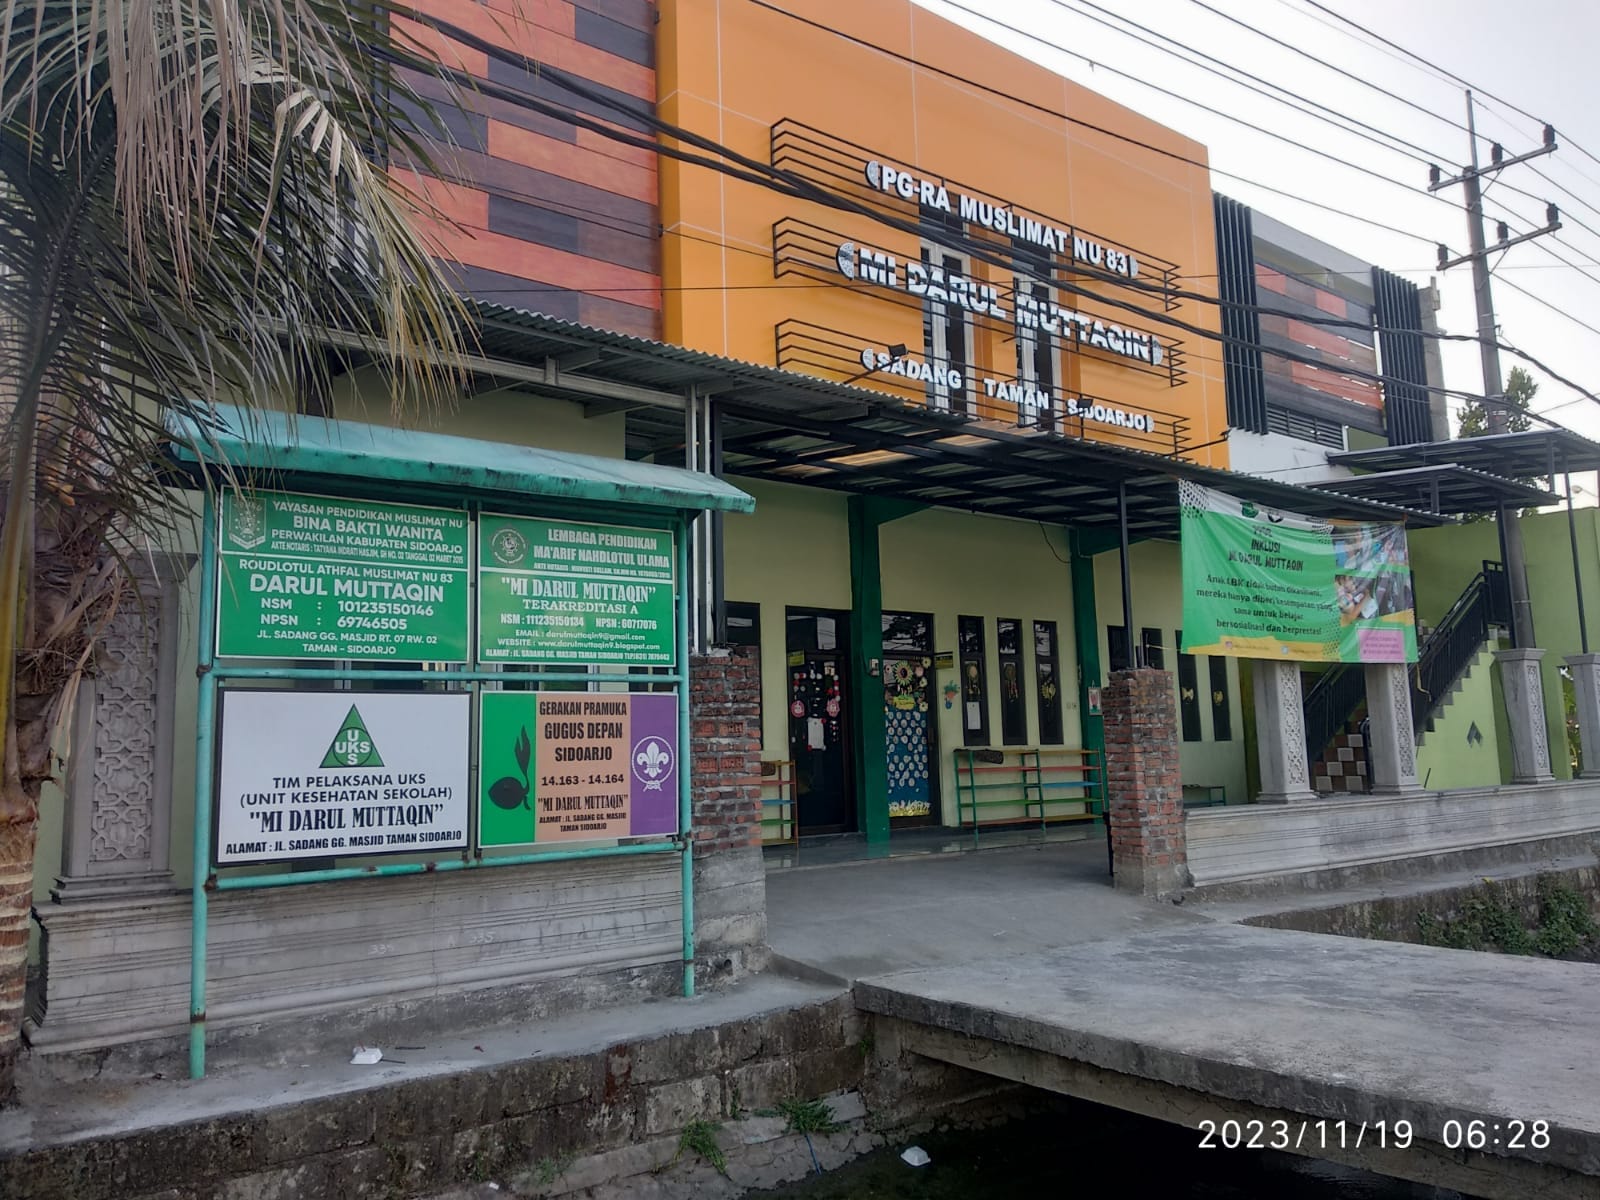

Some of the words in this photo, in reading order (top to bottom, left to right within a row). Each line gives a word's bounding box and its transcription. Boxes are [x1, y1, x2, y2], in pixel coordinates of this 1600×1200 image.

[881, 166, 951, 213] PG-RA
[960, 195, 1068, 251] MUSLIMAT
[1074, 236, 1101, 264] NU
[1105, 248, 1128, 274] 83
[858, 248, 897, 286] MI
[905, 262, 1007, 320] DARUL
[1015, 295, 1151, 360] MUTTAQIN
[876, 353, 962, 390] SADANG
[984, 378, 1049, 409] TAMAN
[273, 501, 324, 514] YAYASAN
[327, 506, 392, 521] PENDIDIKAN
[394, 513, 447, 527] MUSLIMAT
[449, 519, 463, 528] NU
[293, 515, 332, 531] BINA
[335, 519, 380, 535] BAKTI
[384, 524, 444, 541] WANITA
[271, 529, 344, 544] PERWAKILAN
[346, 535, 407, 549] KABUPATEN
[409, 541, 463, 553] SIDOARJO
[548, 529, 596, 544] LEMBAGA
[598, 533, 657, 550] PENDIDIKAN
[1251, 538, 1280, 553] INKLUSI
[534, 545, 576, 560] MA'ARIF
[637, 552, 670, 568] ULAMA
[1265, 555, 1303, 571] MUTTAQIN
[239, 559, 314, 574] ROUDLOTUL
[317, 564, 360, 577] ATHFAL
[363, 568, 419, 581] MUSLIMAT
[422, 571, 438, 582] NU
[440, 573, 453, 583] 83
[250, 574, 328, 596] DARUL
[334, 578, 444, 602] MUTTAQIN
[532, 579, 578, 599] DARUL
[1196, 588, 1227, 599] mereka
[261, 598, 292, 610] NSM
[338, 600, 434, 617] 101235150146
[523, 599, 627, 614] TERAKREDITASI
[630, 605, 638, 614] A
[1253, 609, 1277, 618] untuk
[261, 614, 298, 626] NPSN
[337, 616, 407, 630] 69746505
[501, 613, 520, 624] NSM
[596, 618, 616, 628] NPSN
[257, 630, 272, 639] JL.
[274, 631, 317, 641] SADANG
[319, 632, 338, 641] GG.
[341, 633, 376, 642] MASJID
[379, 634, 392, 642] RT.
[394, 635, 405, 643] 07
[407, 635, 425, 644] RW.
[426, 635, 437, 644] 02
[1266, 623, 1281, 633] dan
[1282, 625, 1321, 636] berprestasi
[302, 644, 337, 653] TAMAN
[347, 646, 396, 655] SIDOARJO
[498, 638, 531, 646] WEBSITE
[539, 701, 582, 716] GERAKAN
[584, 702, 627, 716] PRAMUKA
[544, 723, 584, 739] GUGUS
[587, 722, 623, 739] DEPAN
[335, 741, 370, 753] UKS
[555, 746, 612, 762] SIDOARJO
[273, 777, 300, 789] TIM
[306, 775, 393, 788] PELAKSANA
[398, 774, 426, 785] UKS
[541, 776, 579, 786] 14.163
[589, 774, 624, 785] 14.164
[240, 792, 284, 808] (UNIT
[291, 789, 378, 803] KESEHATAN
[383, 787, 452, 800] SEKOLAH)
[555, 797, 582, 811] DARUL
[250, 810, 283, 833] "MI
[289, 808, 346, 831] DARUL
[580, 823, 607, 831] SIDOARJO
[226, 841, 267, 855] ALAMAT
[274, 841, 287, 852] JL.
[289, 838, 329, 851] SADANG
[331, 838, 347, 849] GG.
[349, 835, 384, 847] MASJID
[386, 833, 417, 845] TAMAN
[419, 831, 462, 843] SIDOARJO
